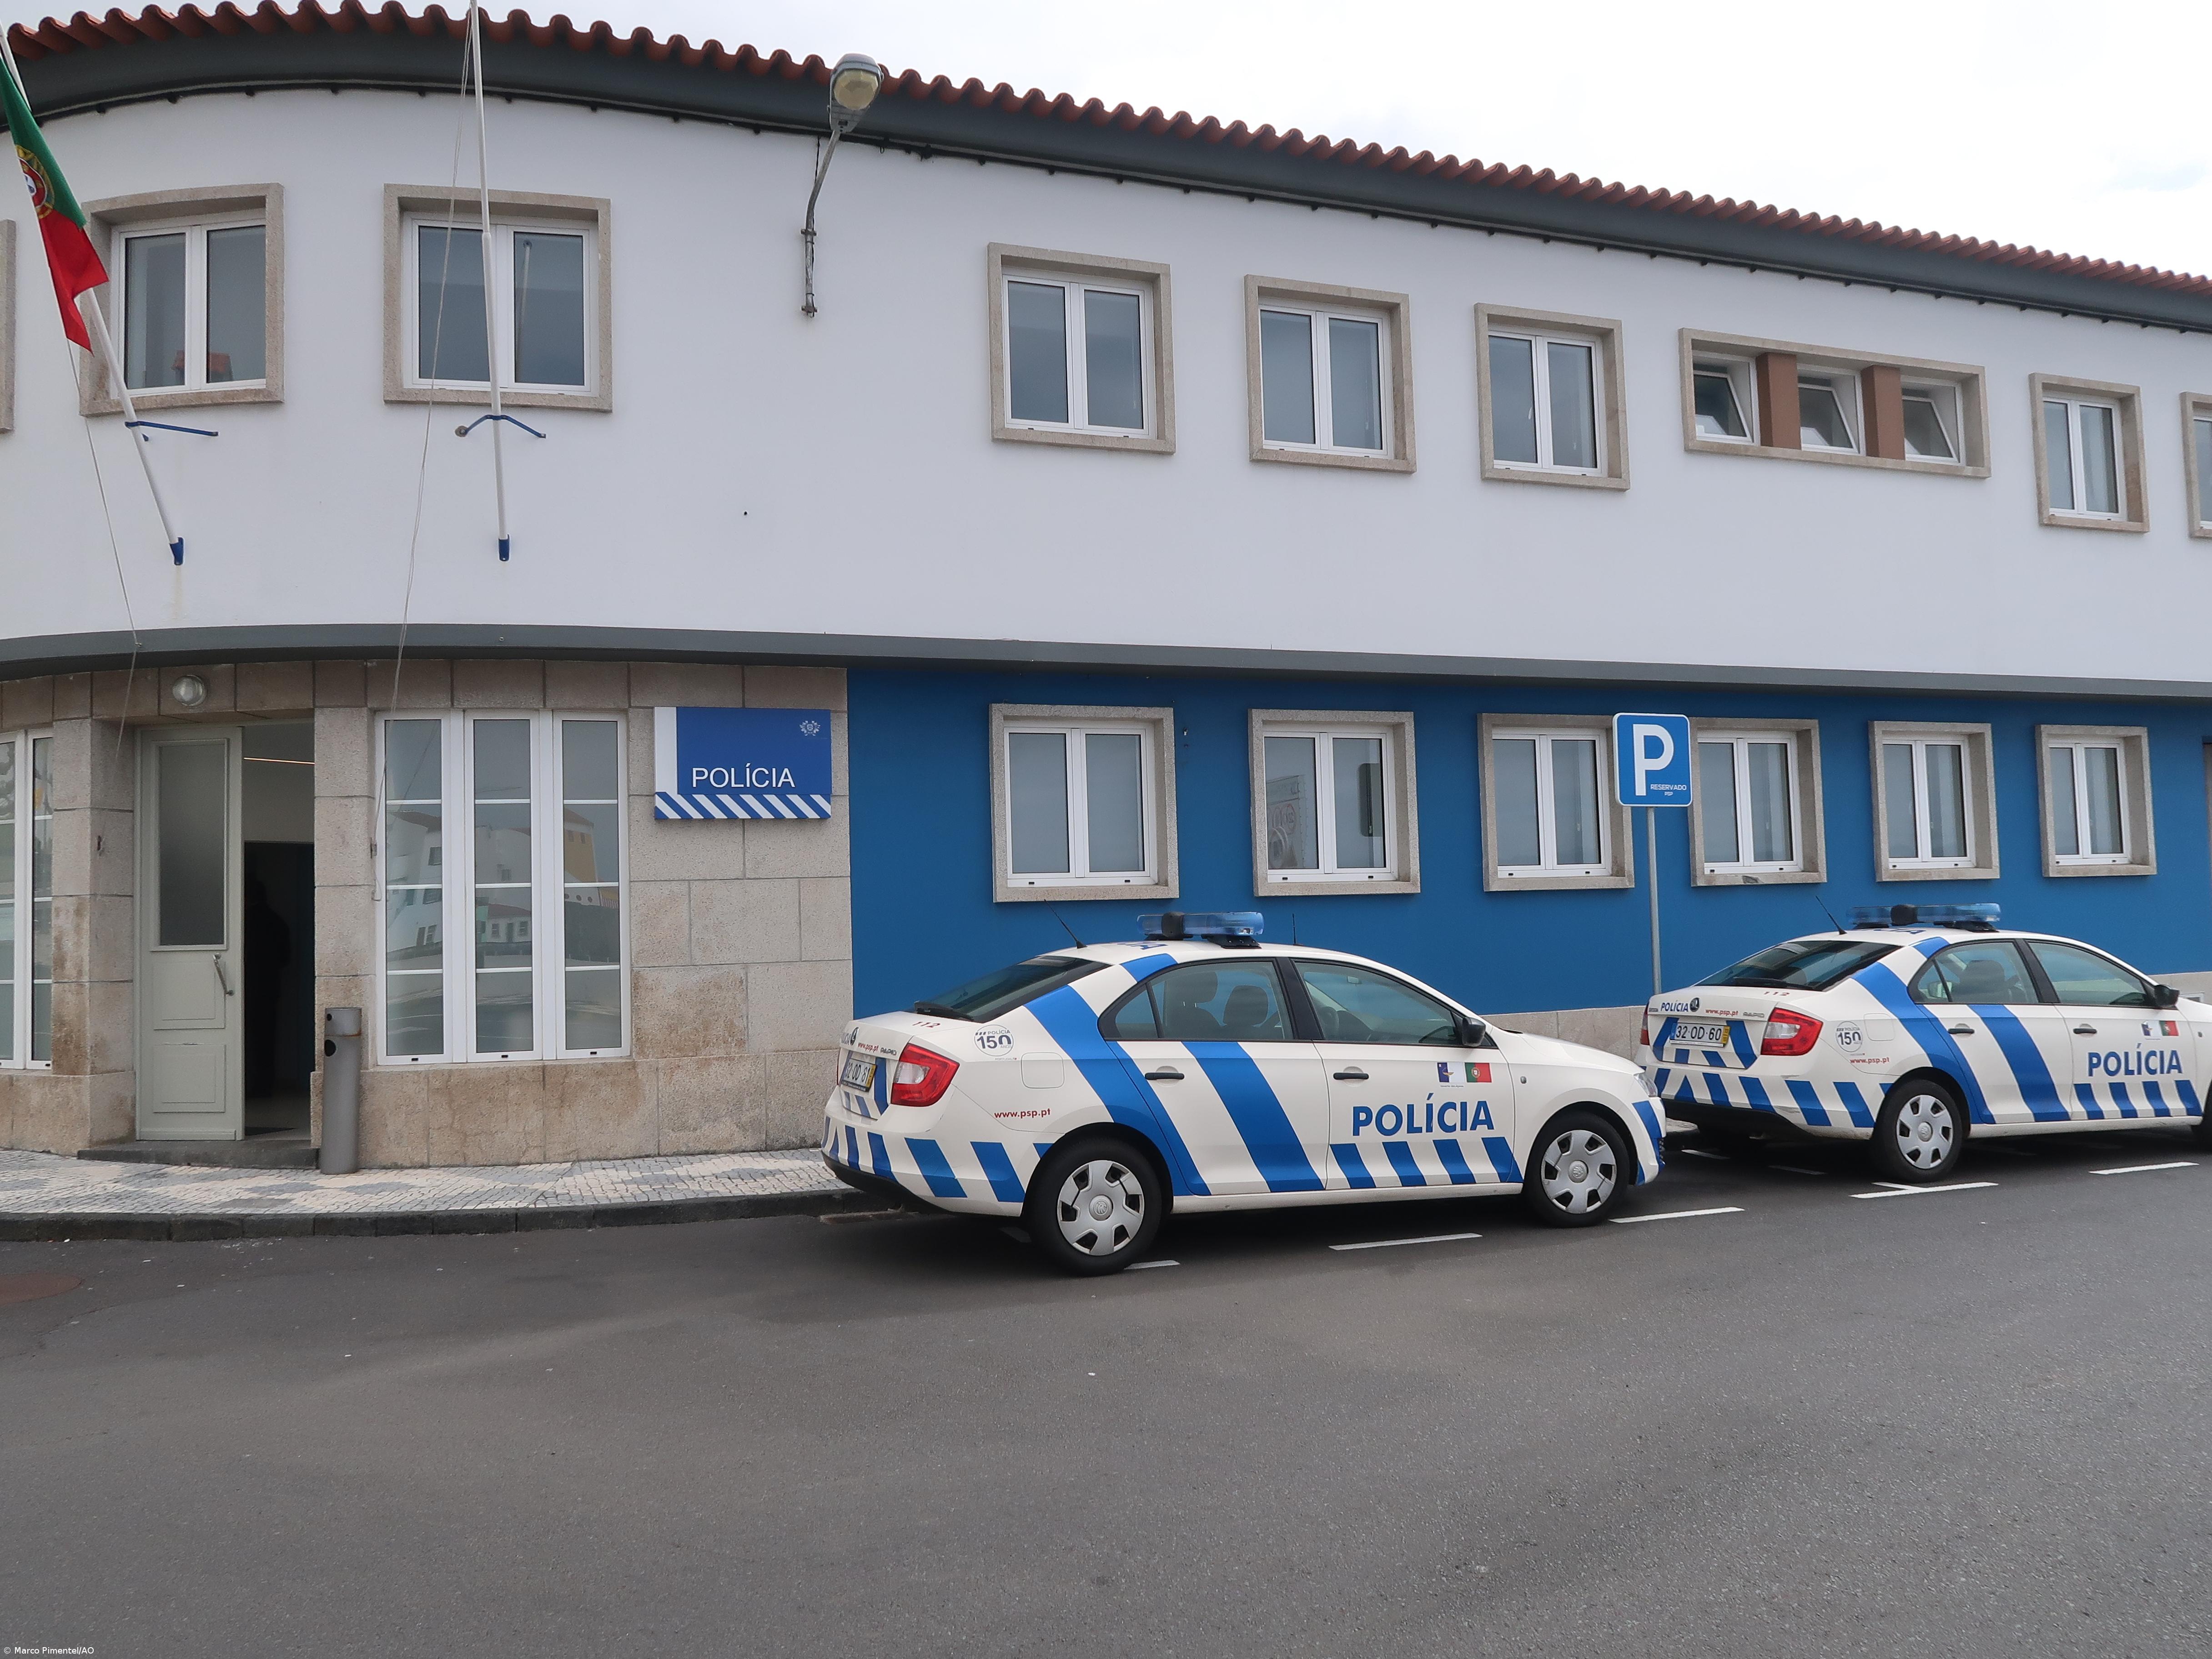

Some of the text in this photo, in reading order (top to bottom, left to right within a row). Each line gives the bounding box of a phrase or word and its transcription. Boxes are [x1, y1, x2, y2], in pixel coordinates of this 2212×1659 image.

[1633, 724, 1674, 796] P
[692, 763, 795, 788] POLÍCIA
[1660, 1000, 1689, 1012] POLÍCIA
[977, 1035, 1011, 1049] 150
[2088, 1043, 2183, 1077] POLÍCIA
[994, 1108, 1051, 1119] www.psp.pt
[1352, 1092, 1495, 1136] POLÍCIA
